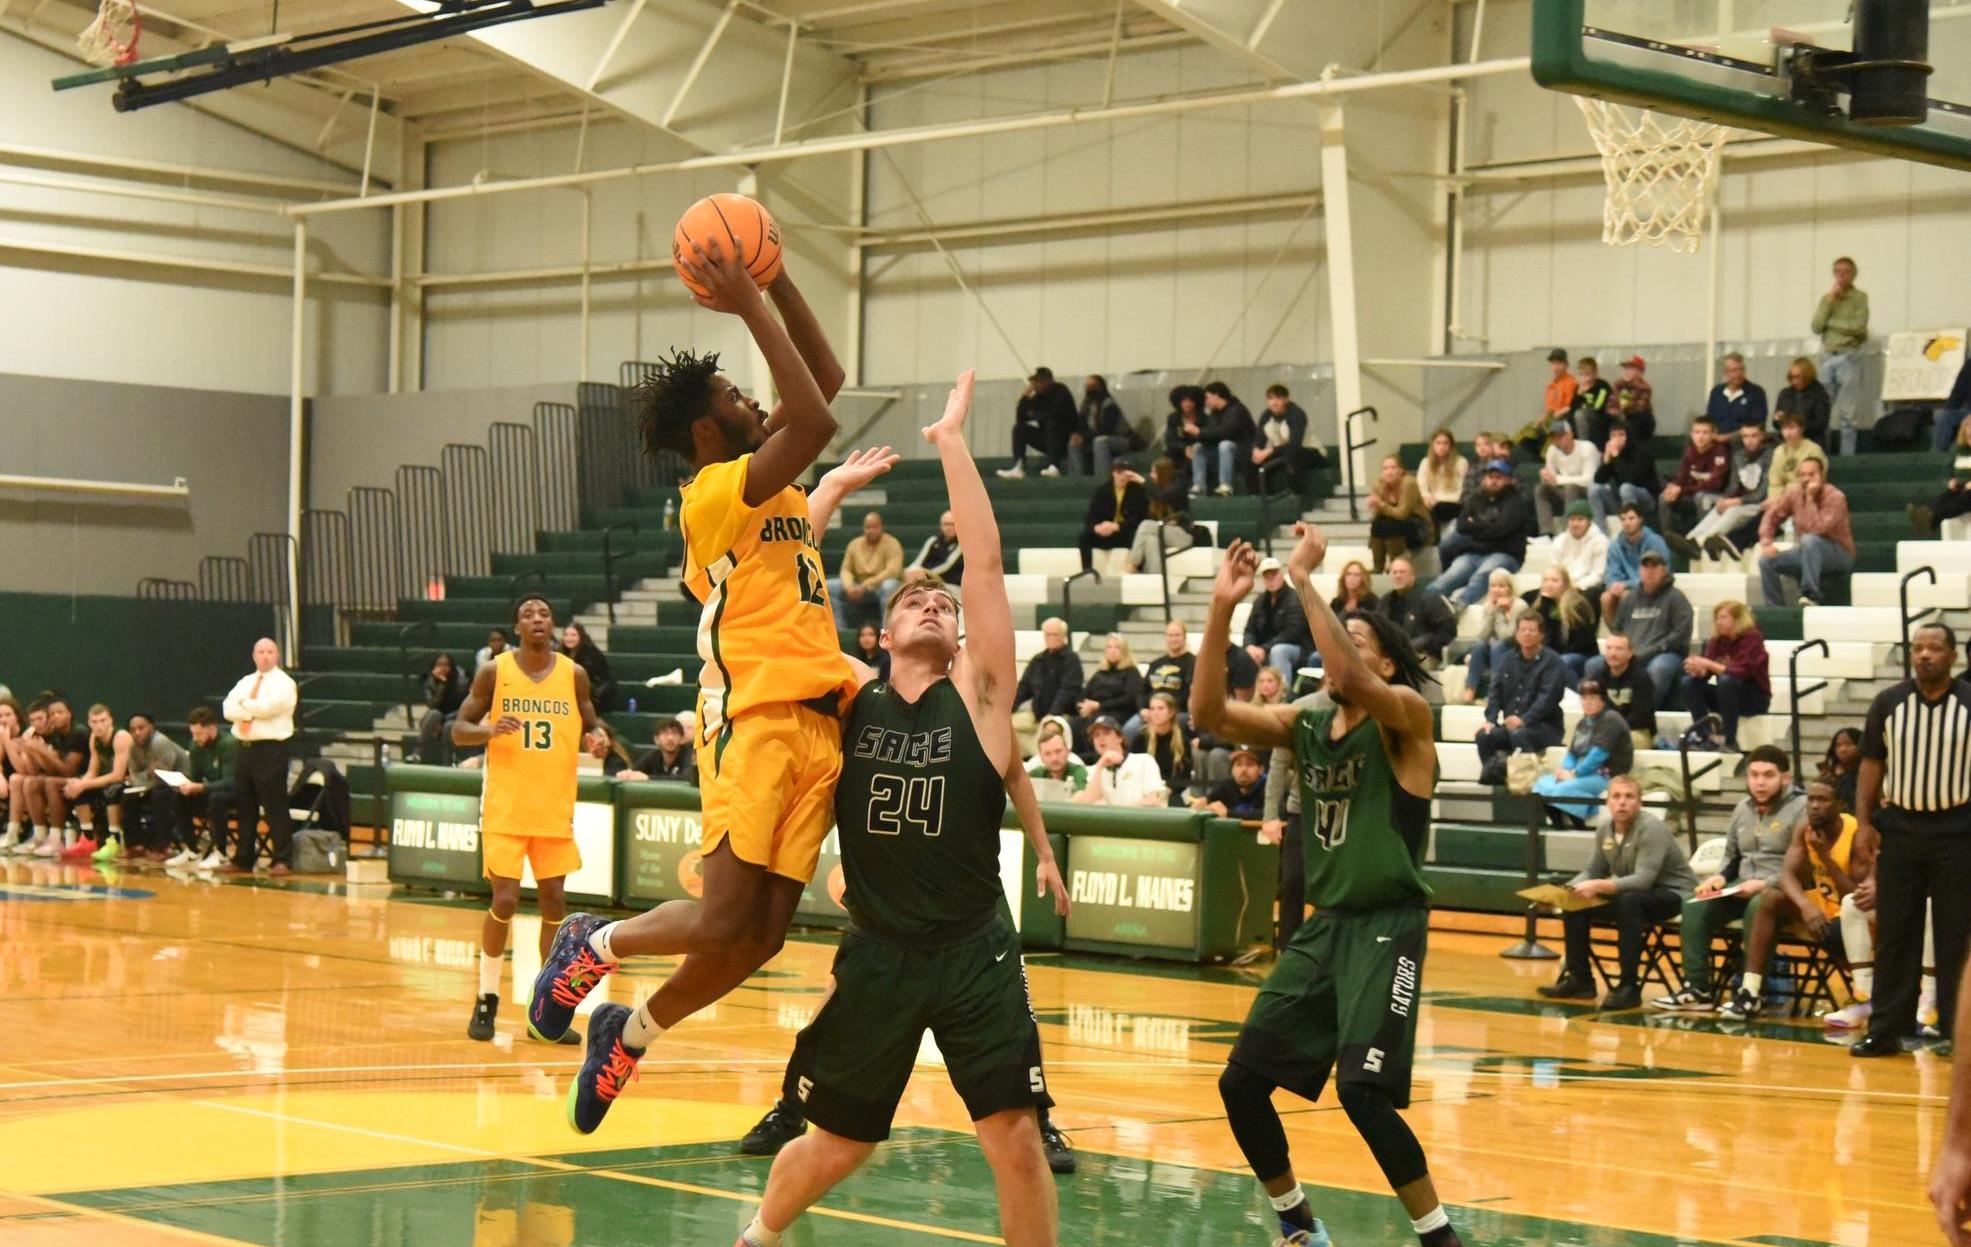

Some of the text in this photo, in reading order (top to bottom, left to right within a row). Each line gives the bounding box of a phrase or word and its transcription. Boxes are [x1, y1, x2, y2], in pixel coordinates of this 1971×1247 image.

[502, 698, 569, 716] BRONCOS
[522, 720, 552, 749] 13
[854, 725, 952, 768] SAGE
[867, 773, 946, 837] 24
[635, 814, 681, 843] SUNY
[1071, 870, 1195, 913] FLOYD L. MAINES
[1390, 956, 1416, 1018] GATORS
